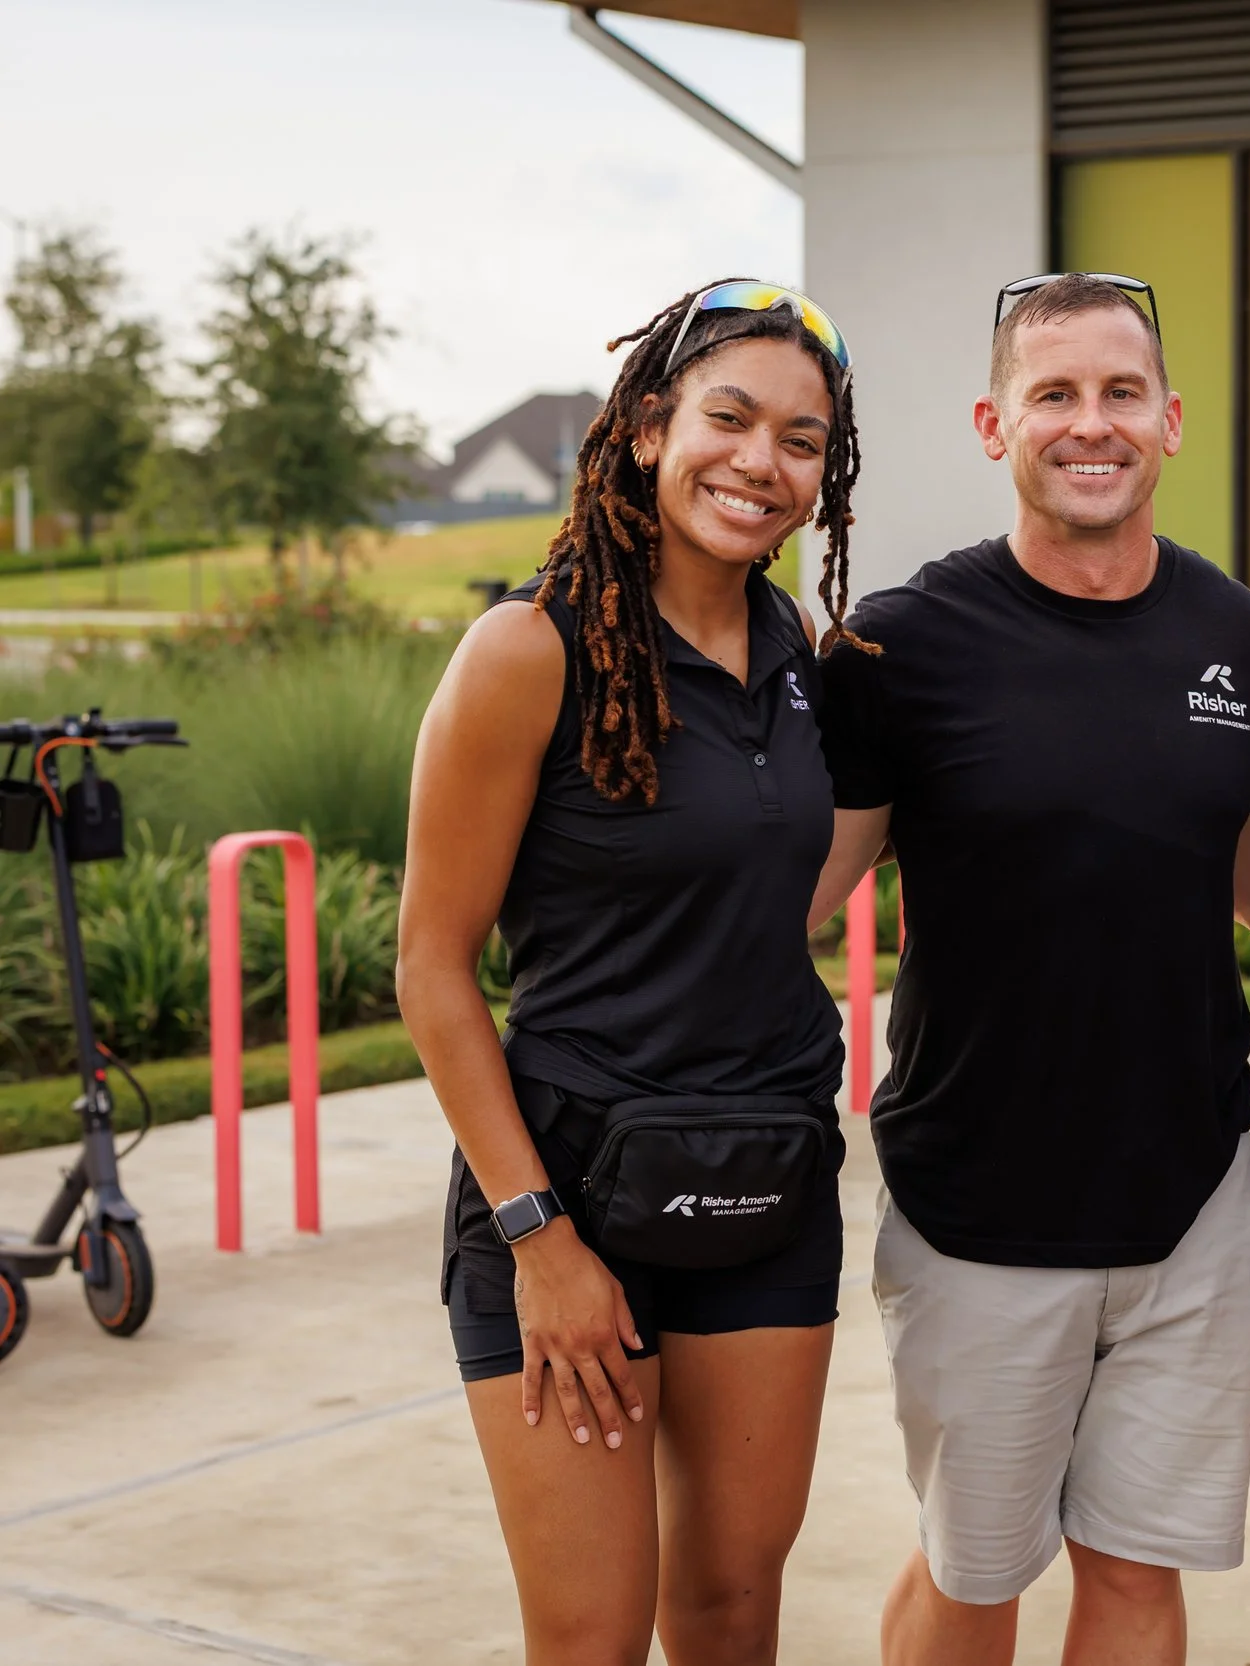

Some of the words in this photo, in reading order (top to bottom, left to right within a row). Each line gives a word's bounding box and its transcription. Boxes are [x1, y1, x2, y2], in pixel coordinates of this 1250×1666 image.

[1188, 691, 1247, 717] Risher
[1189, 715, 1216, 724] AMENITY
[701, 1196, 736, 1207] Risher
[737, 1194, 782, 1206] Amenity
[711, 1206, 768, 1216] MANAGEMENT
